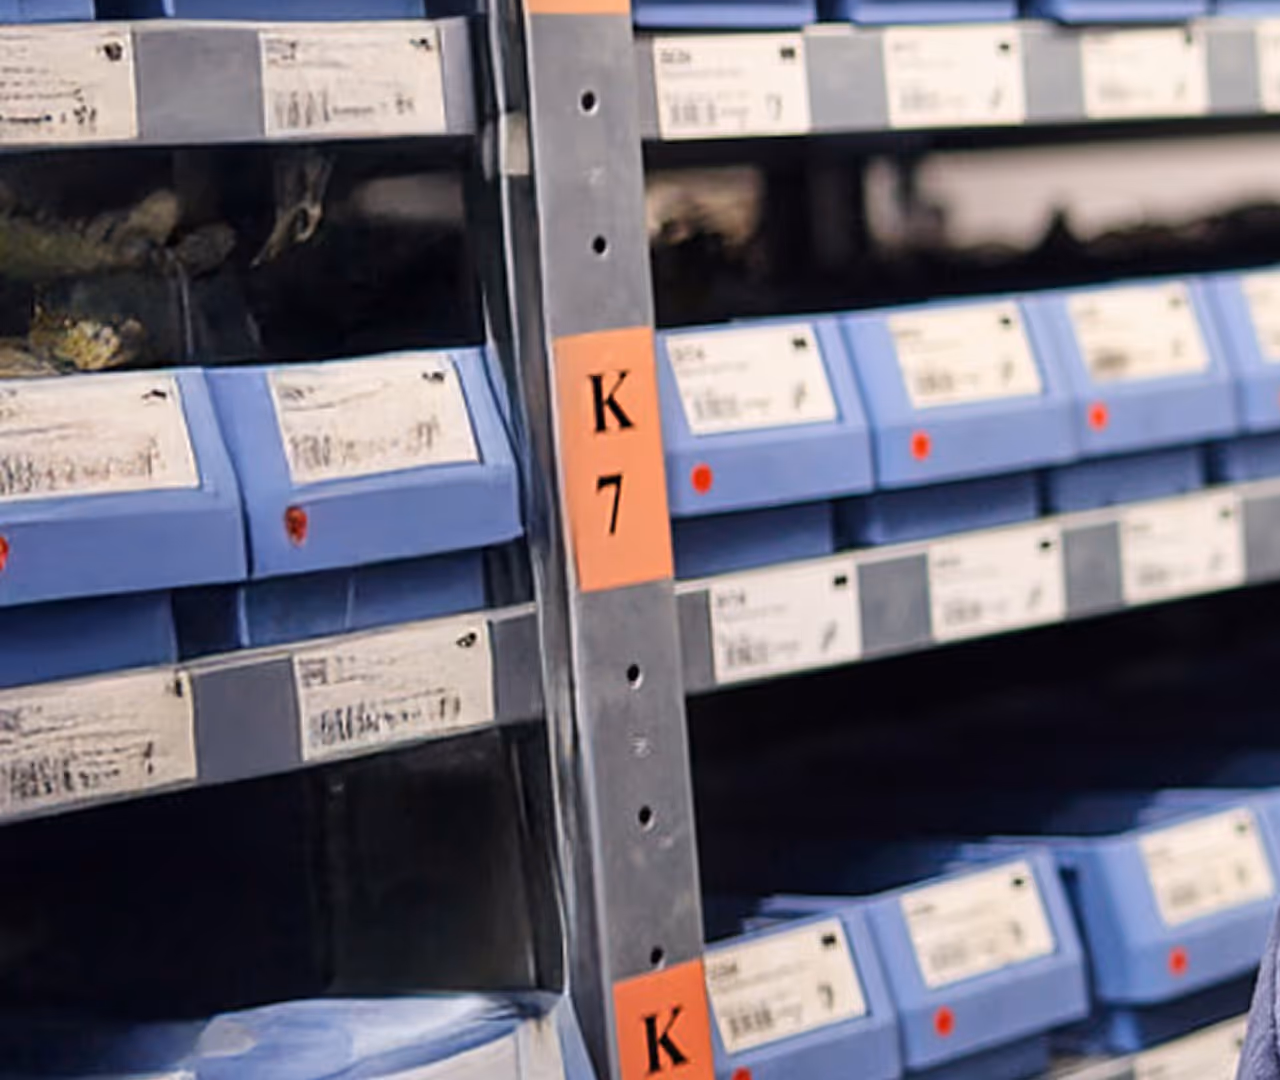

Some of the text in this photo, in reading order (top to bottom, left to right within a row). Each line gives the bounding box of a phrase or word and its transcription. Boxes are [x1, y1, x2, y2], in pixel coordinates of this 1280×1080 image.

[587, 370, 634, 433] K
[596, 474, 622, 535] 7
[641, 1004, 690, 1074] K
